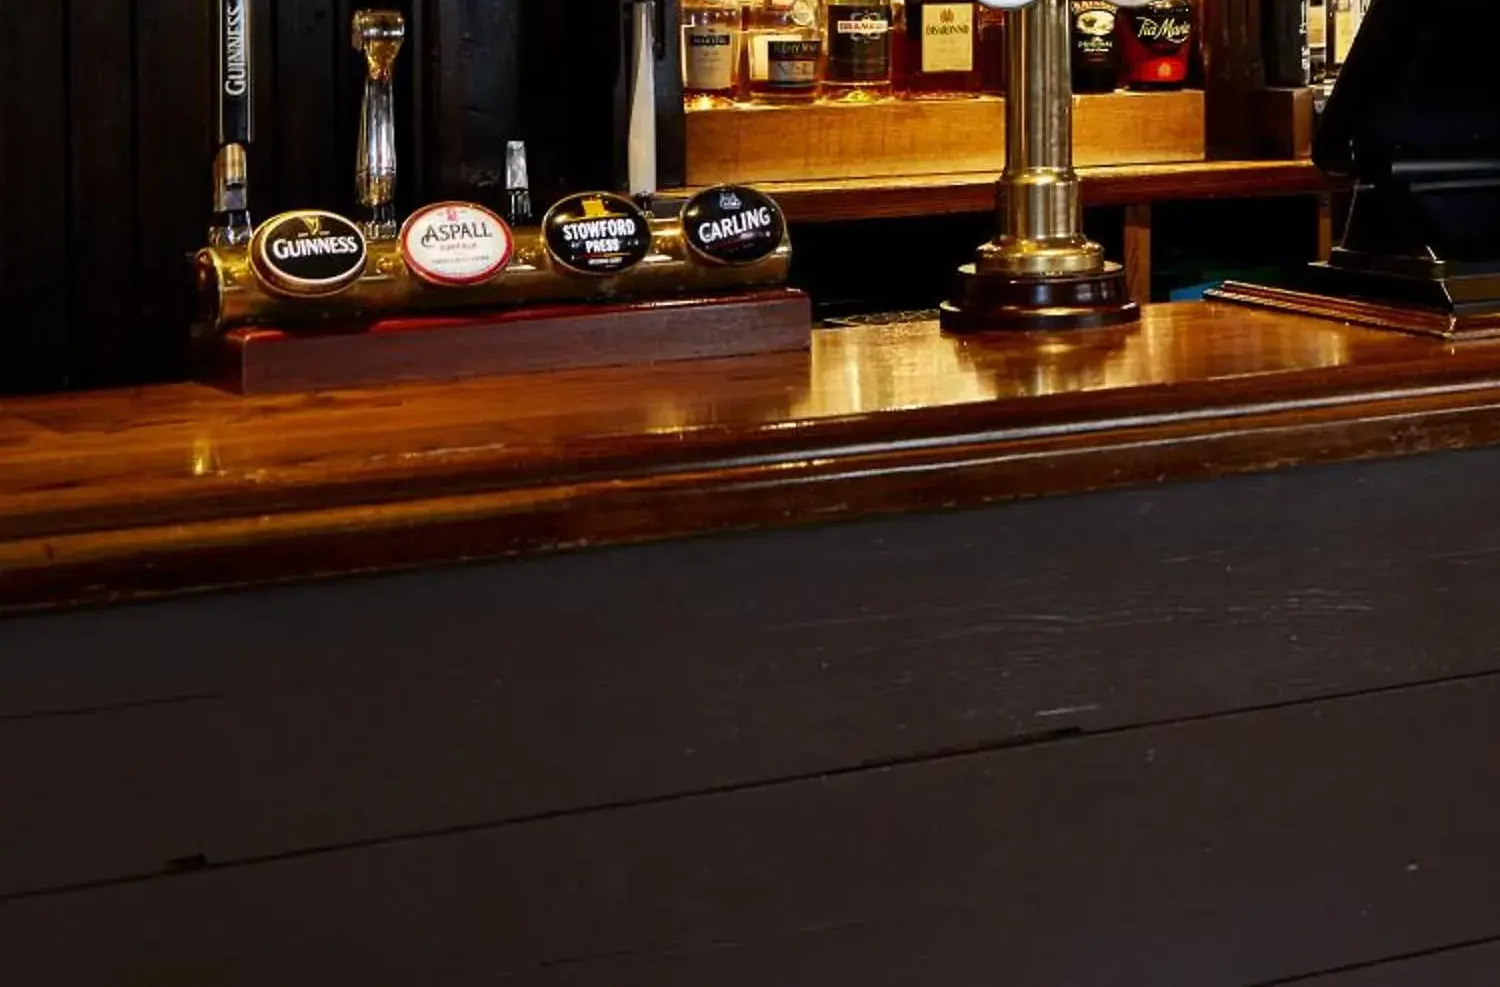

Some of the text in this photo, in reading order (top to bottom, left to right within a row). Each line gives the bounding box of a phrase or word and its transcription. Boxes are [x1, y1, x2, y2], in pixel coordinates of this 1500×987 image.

[224, 5, 248, 96] GUINNESS
[421, 221, 494, 249] ASPALL
[562, 218, 636, 242] STOWFORD
[697, 206, 771, 243] CARLING
[271, 235, 359, 261] GUINNESS
[584, 238, 621, 254] PRESS
